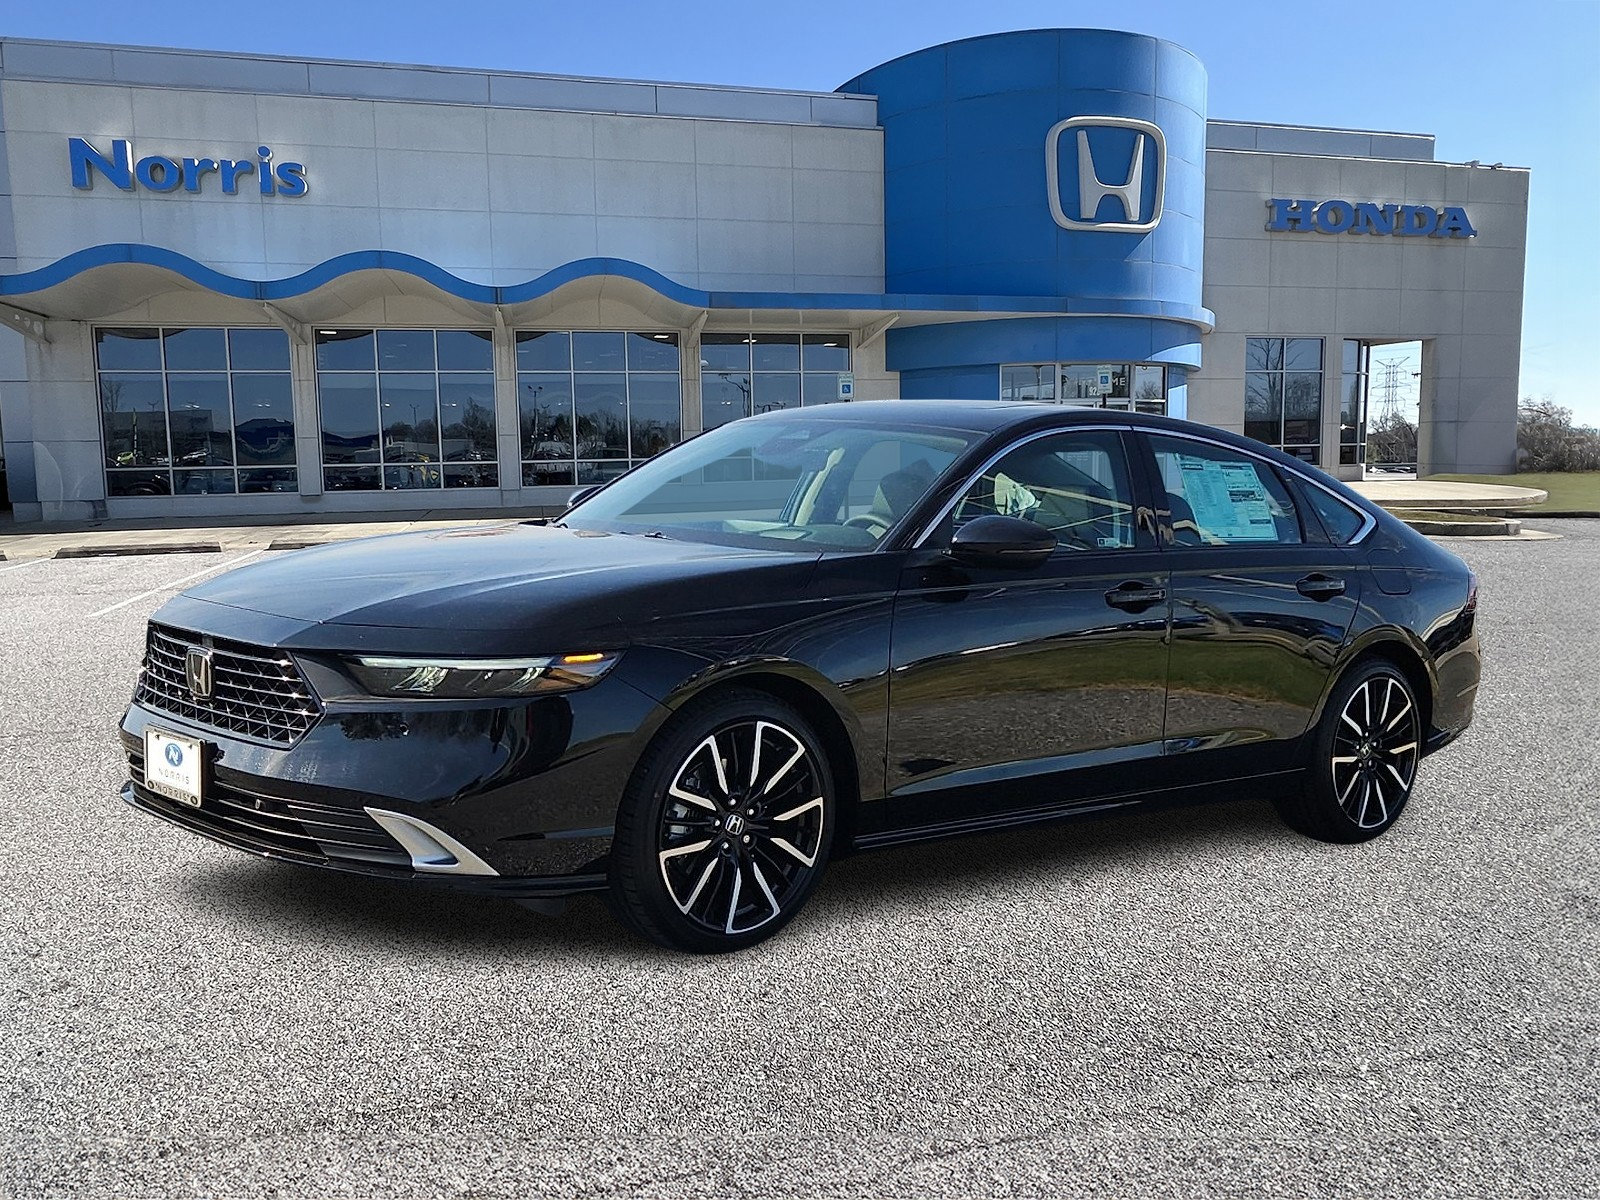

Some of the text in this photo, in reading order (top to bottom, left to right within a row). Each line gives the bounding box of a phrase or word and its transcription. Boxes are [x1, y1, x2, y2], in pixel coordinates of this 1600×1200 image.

[68, 137, 309, 198] Norris
[1265, 198, 1478, 238] HONDA
[158, 767, 190, 785] NORRIS
[155, 781, 188, 802] NORRIS
